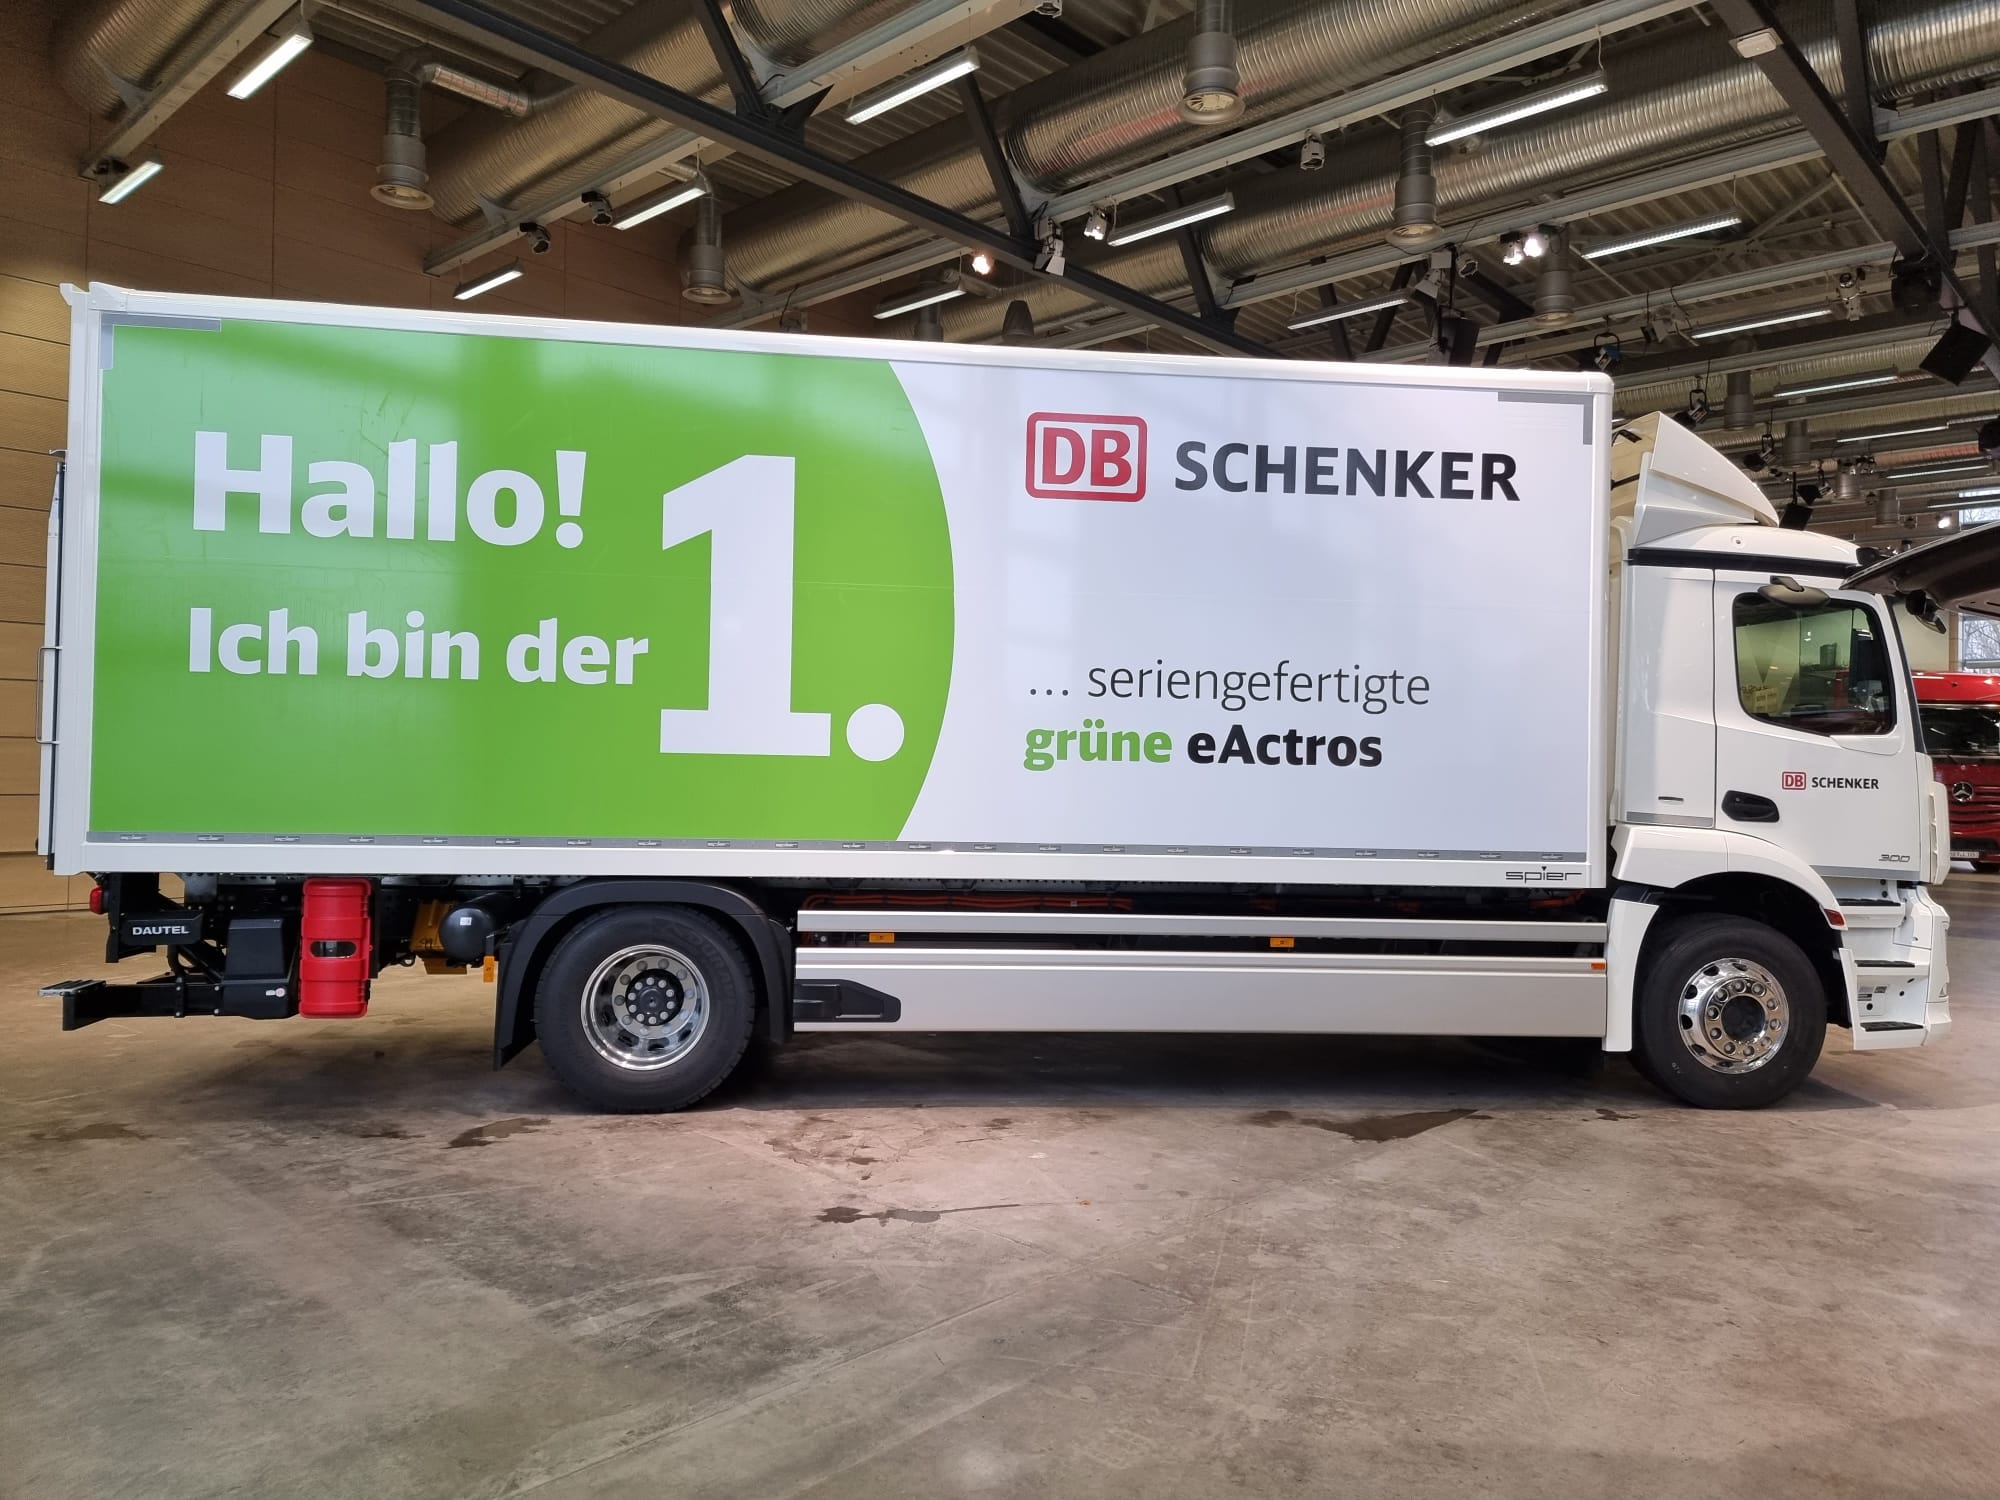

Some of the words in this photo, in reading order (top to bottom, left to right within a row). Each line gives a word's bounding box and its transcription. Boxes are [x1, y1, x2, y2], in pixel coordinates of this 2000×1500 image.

[193, 430, 586, 549] Hallo!
[1042, 427, 1132, 487] DB
[1175, 440, 1521, 502] SCHENKER
[190, 607, 319, 675] Ich
[347, 610, 480, 680] bin
[506, 618, 649, 685] der
[660, 455, 905, 761] 1.
[1087, 659, 1430, 712] seriengefertigte
[1024, 719, 1172, 772] grüne
[1187, 724, 1383, 768] eActros
[1784, 774, 1804, 788] DB
[1811, 776, 1880, 790] SCHENKER
[1505, 866, 1584, 885] spier
[132, 925, 190, 936] DAUTEL
